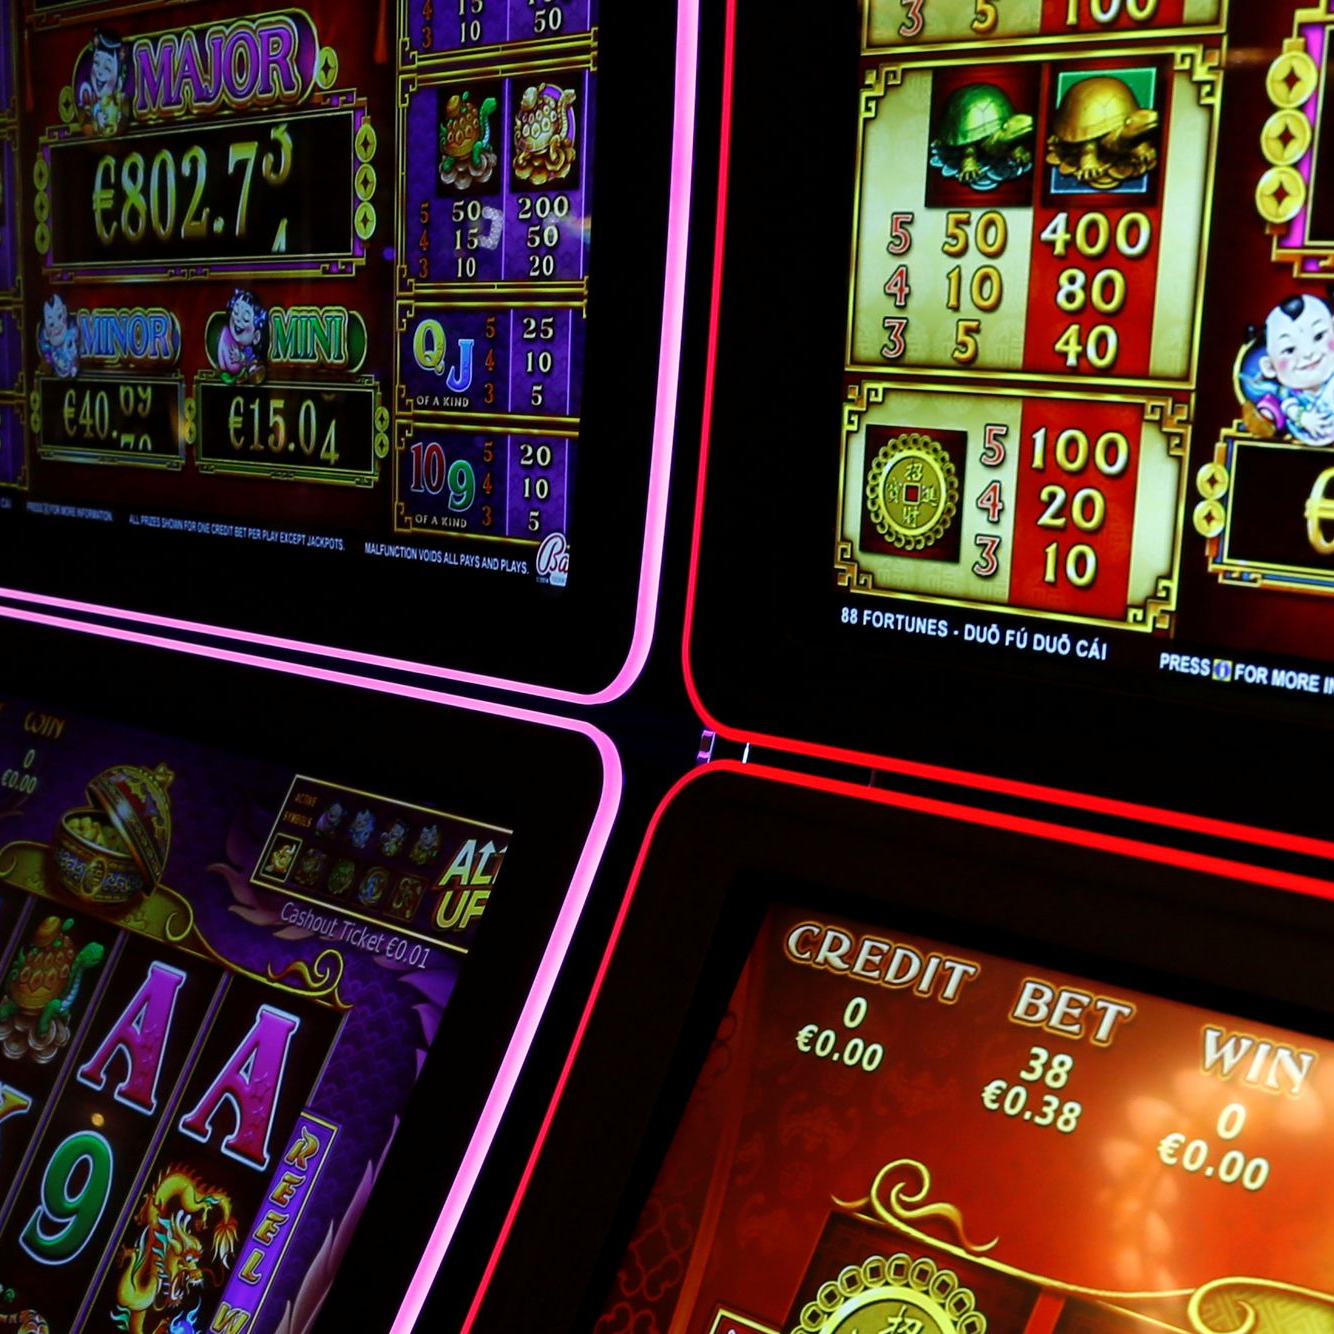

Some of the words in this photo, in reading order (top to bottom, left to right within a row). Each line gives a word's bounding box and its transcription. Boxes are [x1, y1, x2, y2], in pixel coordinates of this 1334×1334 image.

[460, 20, 481, 43] 10
[534, 7, 562, 34] 50
[136, 27, 295, 111] MAJOR
[452, 201, 482, 223] 50
[518, 196, 569, 220] 200
[887, 212, 914, 255] 5
[941, 211, 1008, 258] 50
[1040, 211, 1152, 258] 400
[527, 225, 560, 248] 50
[457, 257, 477, 279] 10
[529, 255, 555, 277] 20
[884, 264, 910, 308] 4
[946, 264, 1003, 313] 10
[1056, 268, 1126, 314] 80
[78, 311, 171, 360] MINOR
[271, 313, 347, 363] MINI
[522, 317, 555, 340] 25
[881, 317, 908, 360] 3
[952, 319, 981, 364] 5
[1054, 324, 1118, 369] 40
[413, 319, 447, 377] Q
[446, 339, 476, 393] J
[526, 351, 552, 374] 10
[520, 443, 552, 467] 20
[980, 424, 1009, 466] 5
[1031, 427, 1131, 477] 100
[411, 442, 446, 495] 10
[447, 459, 476, 512] 9
[523, 477, 549, 499] 10
[977, 481, 1004, 523] 4
[1036, 484, 1106, 532] 20
[211, 523, 233, 537] CREDIT
[234, 526, 247, 538] BET
[248, 527, 261, 540] PER
[262, 530, 279, 542] PLAY
[279, 531, 306, 546] EXCEPT
[307, 535, 346, 551] JACKPOTS.
[365, 542, 417, 560] MALFUNCTION
[418, 549, 442, 564] VOIDS
[443, 552, 458, 566] ALL
[459, 554, 480, 569] PAYS
[481, 557, 498, 571] AND
[500, 560, 529, 575] PLAYS.
[972, 535, 1002, 578] 3
[1043, 541, 1098, 588] 10
[841, 607, 858, 625] 88
[863, 610, 948, 638] FORTUNES
[1075, 638, 1107, 661] CÁI
[1160, 653, 1211, 676] PRESS
[1234, 663, 1268, 685] FOR
[1271, 669, 1320, 693] MORE
[1, 769, 38, 794] €0.00
[280, 901, 335, 939] Cashout
[339, 919, 387, 955] Ticket
[386, 936, 432, 970] €0.01
[785, 922, 978, 1004] CREDIT
[1010, 977, 1135, 1045] BET
[1200, 1025, 1317, 1098] WIN
[77, 960, 187, 1115] A
[179, 1003, 302, 1172] A
[842, 996, 867, 1030] 0
[1019, 1046, 1074, 1090] 38
[1216, 1103, 1247, 1139] 0
[795, 1023, 885, 1073] €0.00
[980, 1079, 1082, 1134] €0.38
[1157, 1131, 1270, 1192] €0.00
[18, 1130, 114, 1266] 9
[236, 1124, 321, 1285] REEL
